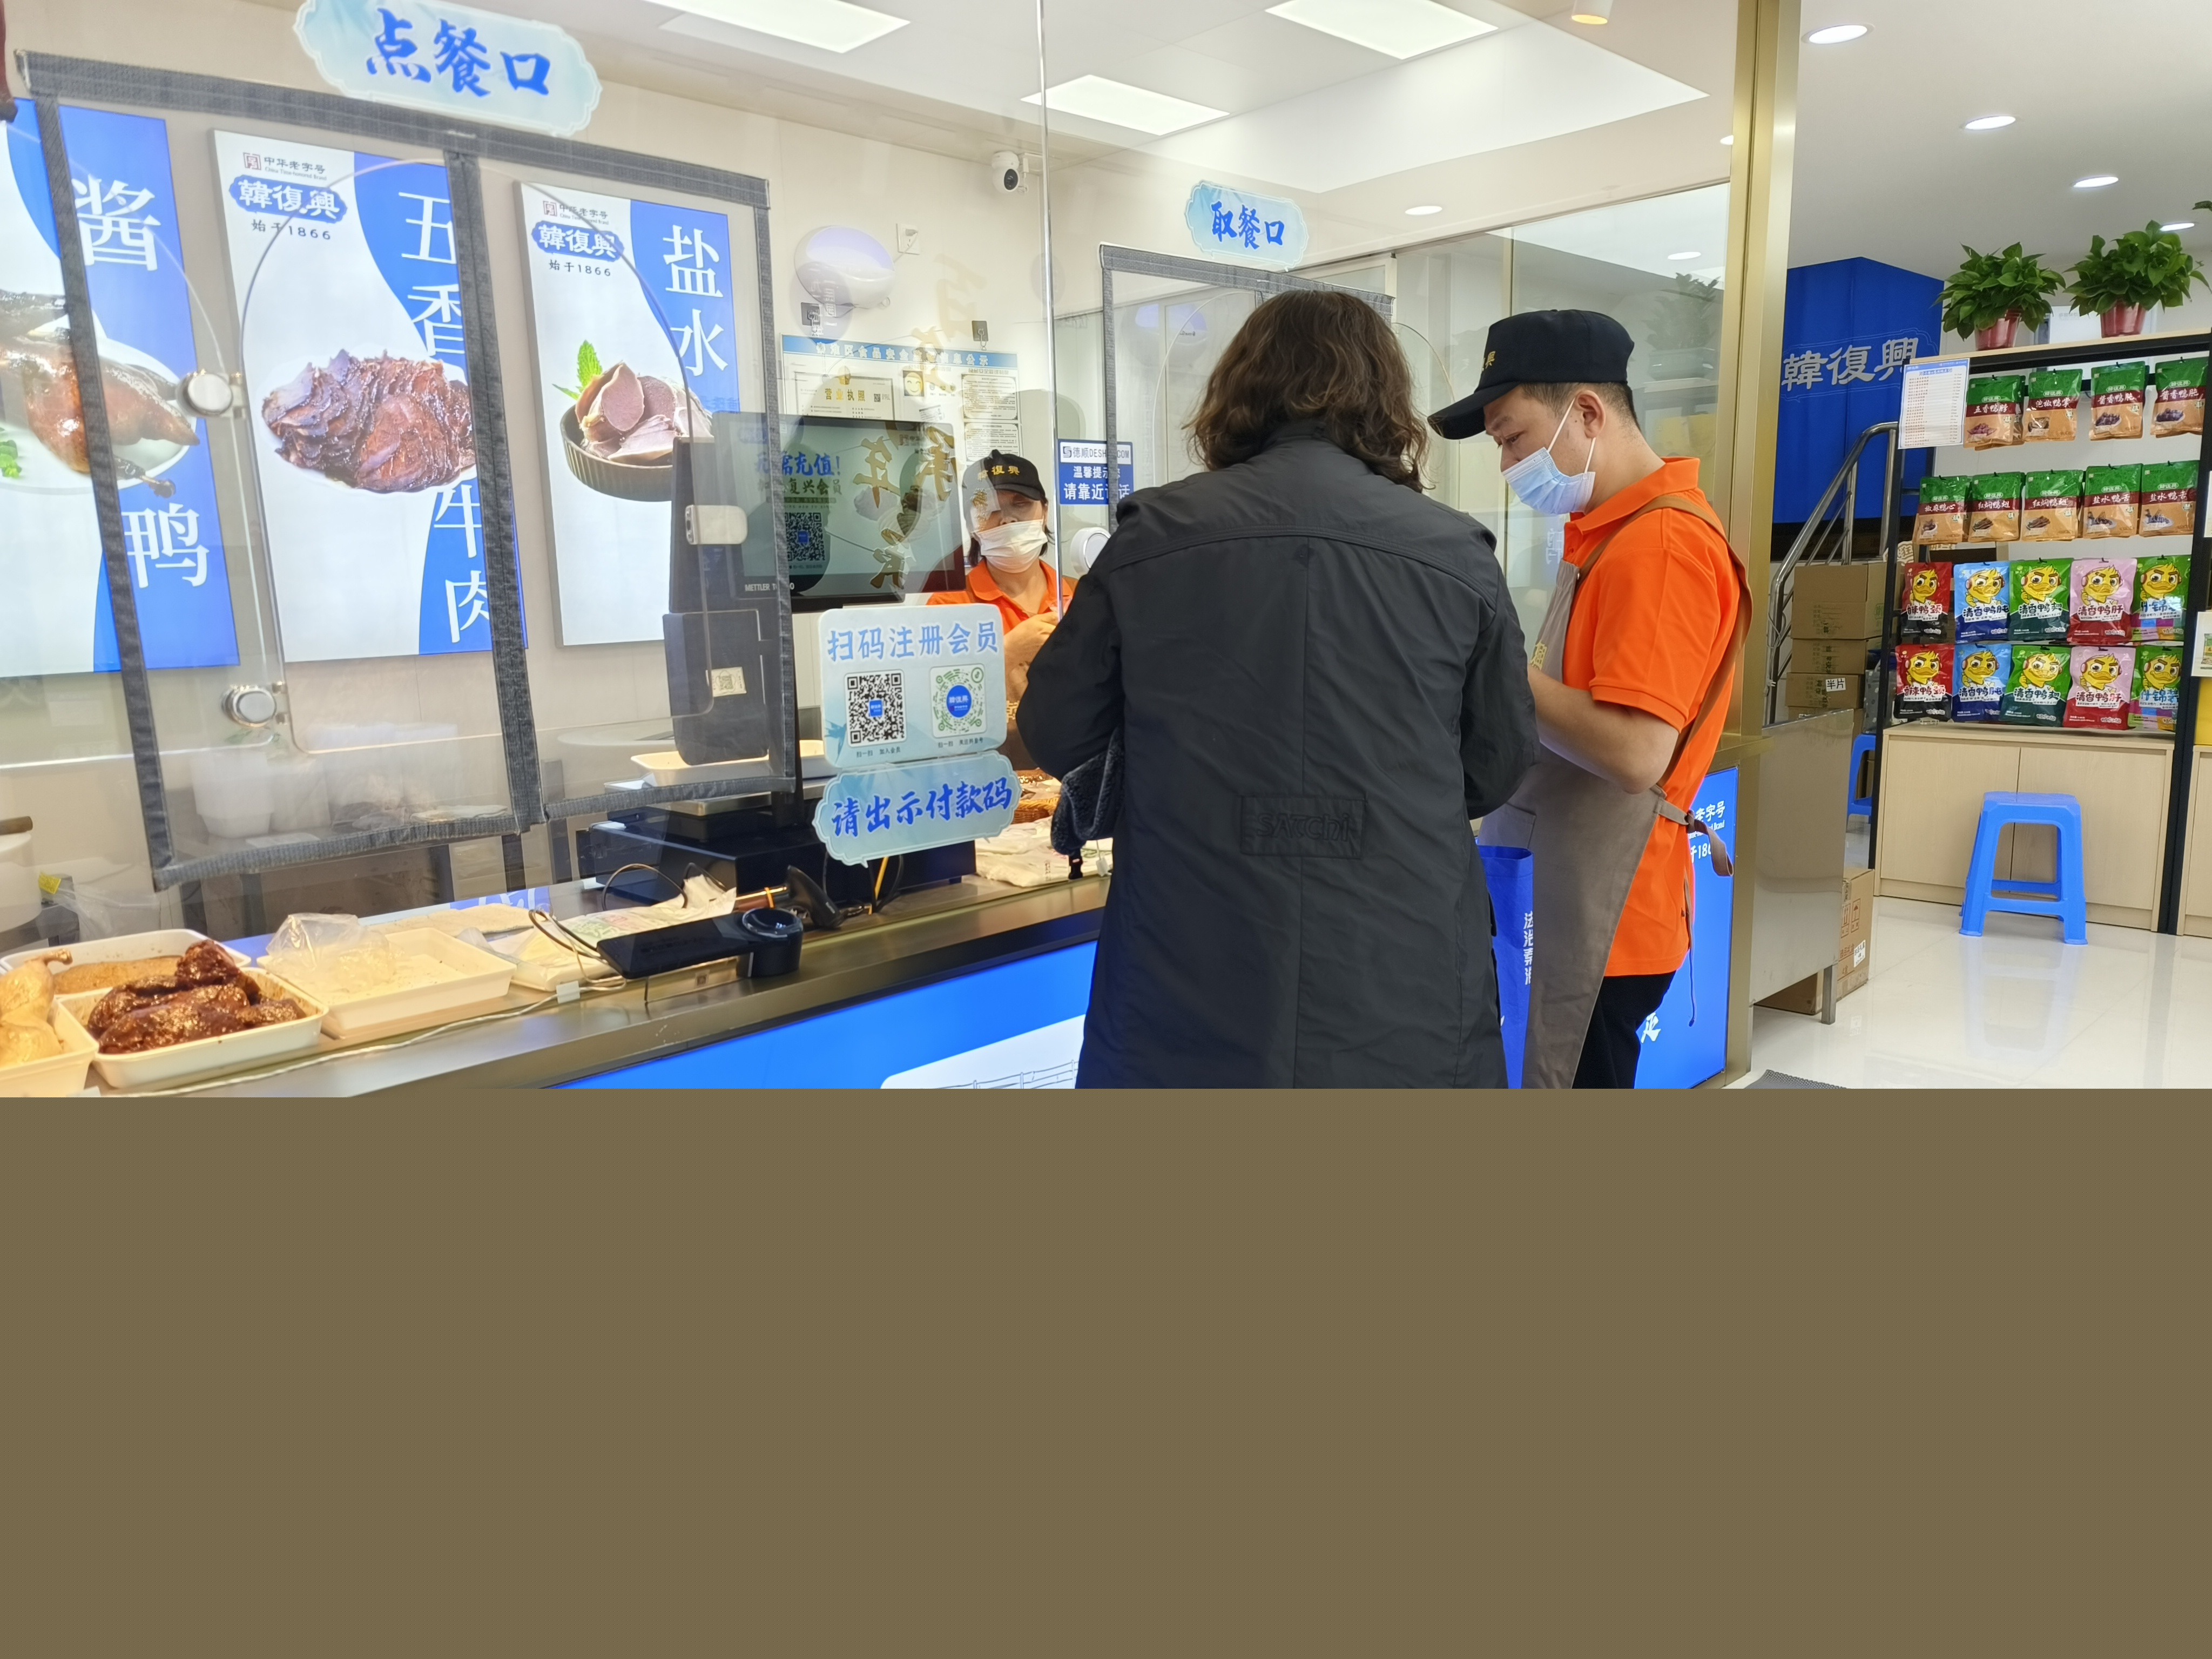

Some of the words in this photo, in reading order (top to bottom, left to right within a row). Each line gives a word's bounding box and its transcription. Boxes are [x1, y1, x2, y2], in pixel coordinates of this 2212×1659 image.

[366, 8, 550, 97] 点餐口
[264, 157, 325, 174] 中华老字号
[238, 179, 340, 219] 韓復興
[538, 224, 617, 259] 韓復興
[1210, 200, 1285, 250] 取餐口
[662, 225, 728, 377] 盐水
[71, 174, 161, 271] 酱
[121, 503, 210, 589] 鸭
[1781, 336, 1919, 392] 韓復興
[824, 388, 866, 403] 营业执照
[1063, 482, 1130, 501] 请靠近话
[745, 583, 770, 592] METTLER
[2078, 604, 2124, 616] 清香鸭肝
[827, 621, 999, 663] 扫码注册会员
[1827, 679, 1845, 690] 半片
[2076, 692, 2122, 703] 清香鸭肝
[831, 776, 1013, 838] 请出示付款码
